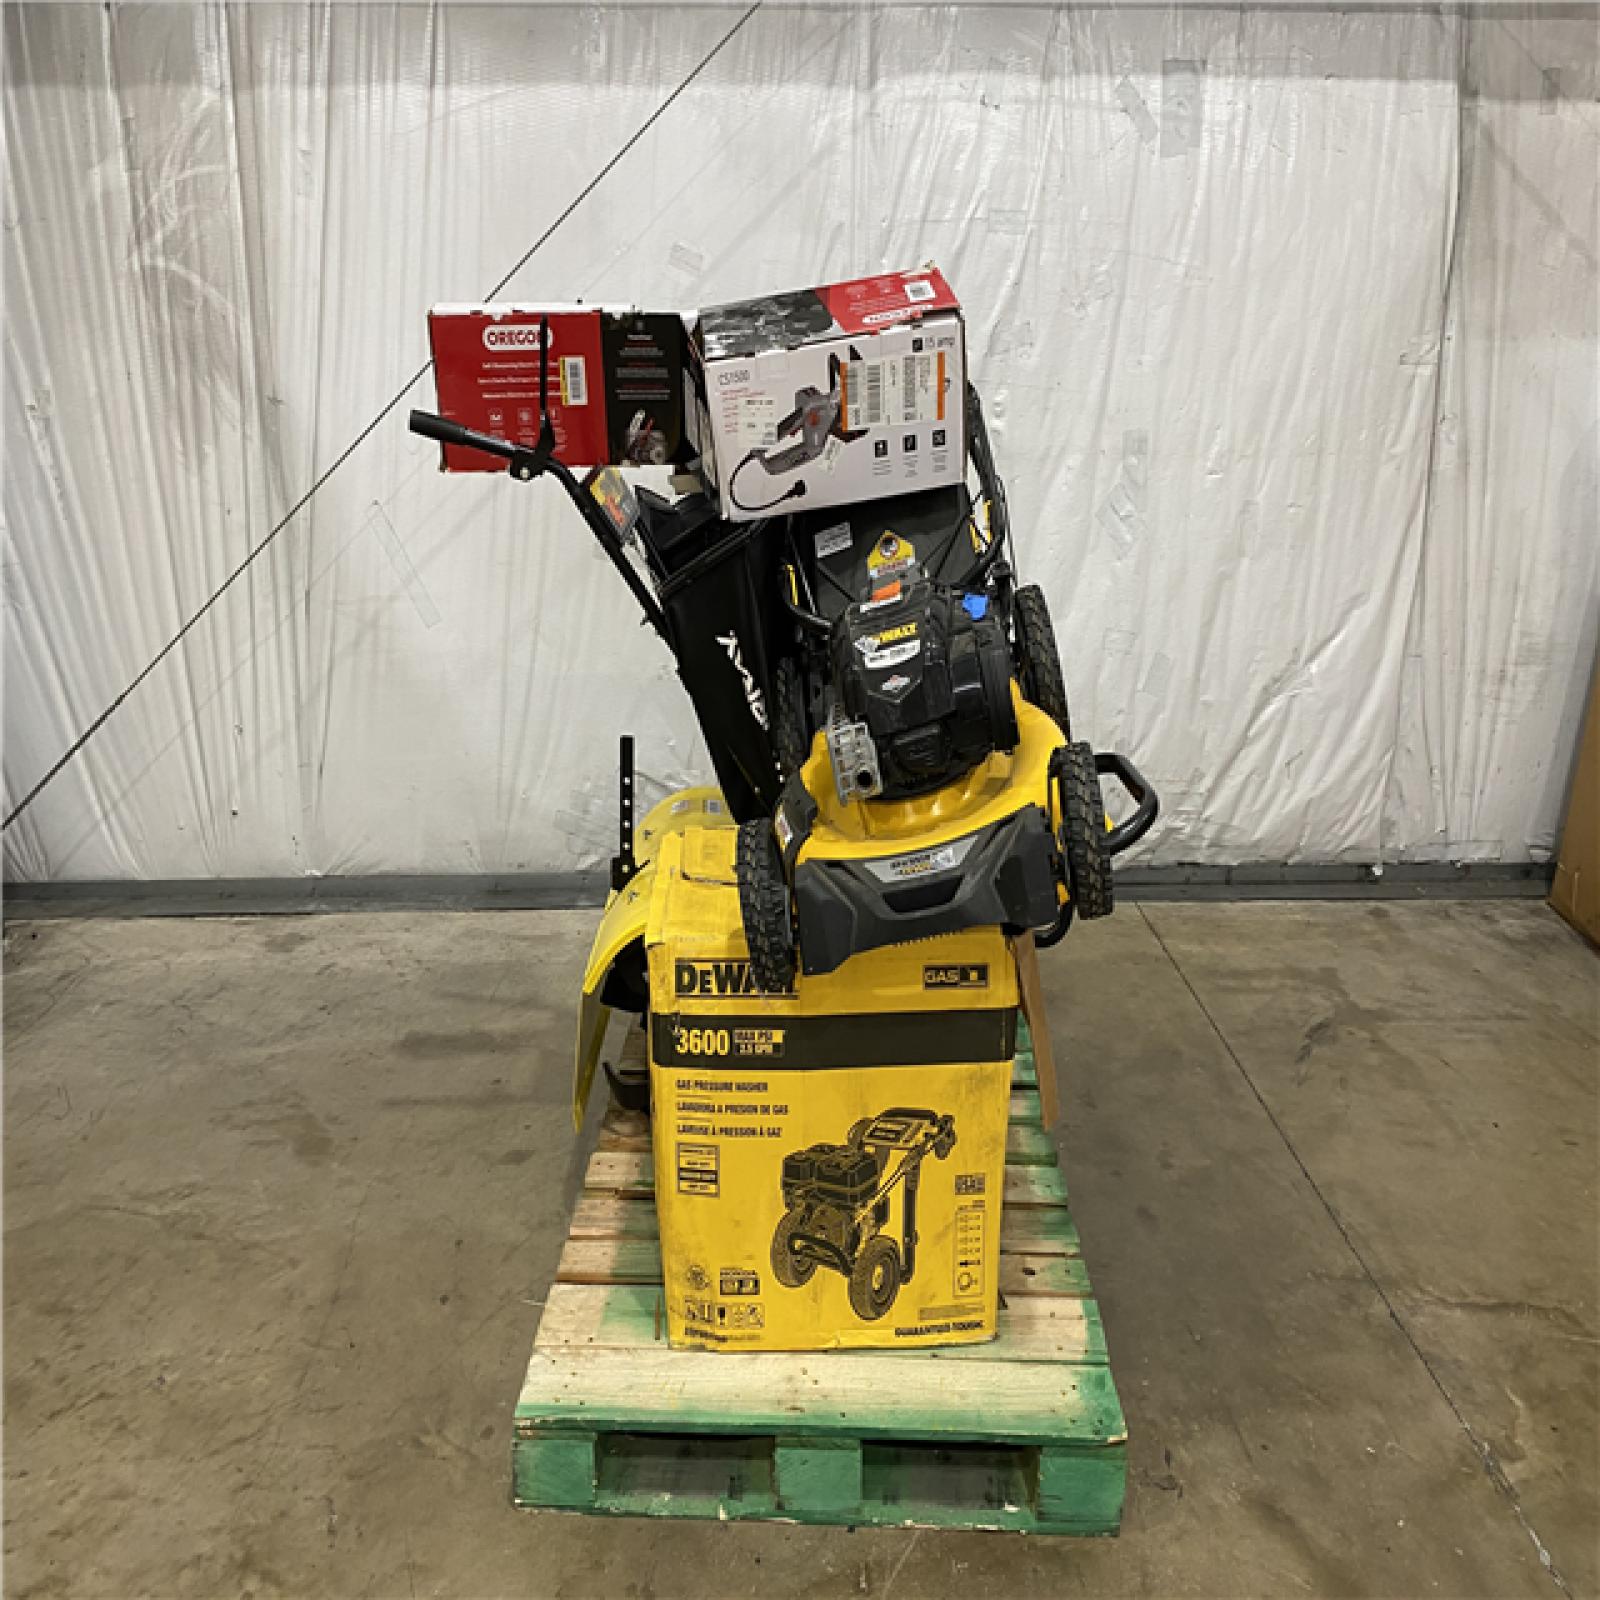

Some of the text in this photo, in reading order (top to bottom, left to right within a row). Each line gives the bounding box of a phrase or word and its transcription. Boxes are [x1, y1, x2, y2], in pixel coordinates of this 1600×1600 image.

[487, 329, 547, 346] OREGO
[925, 969, 959, 983] GAS
[675, 1029, 730, 1055] 3600
